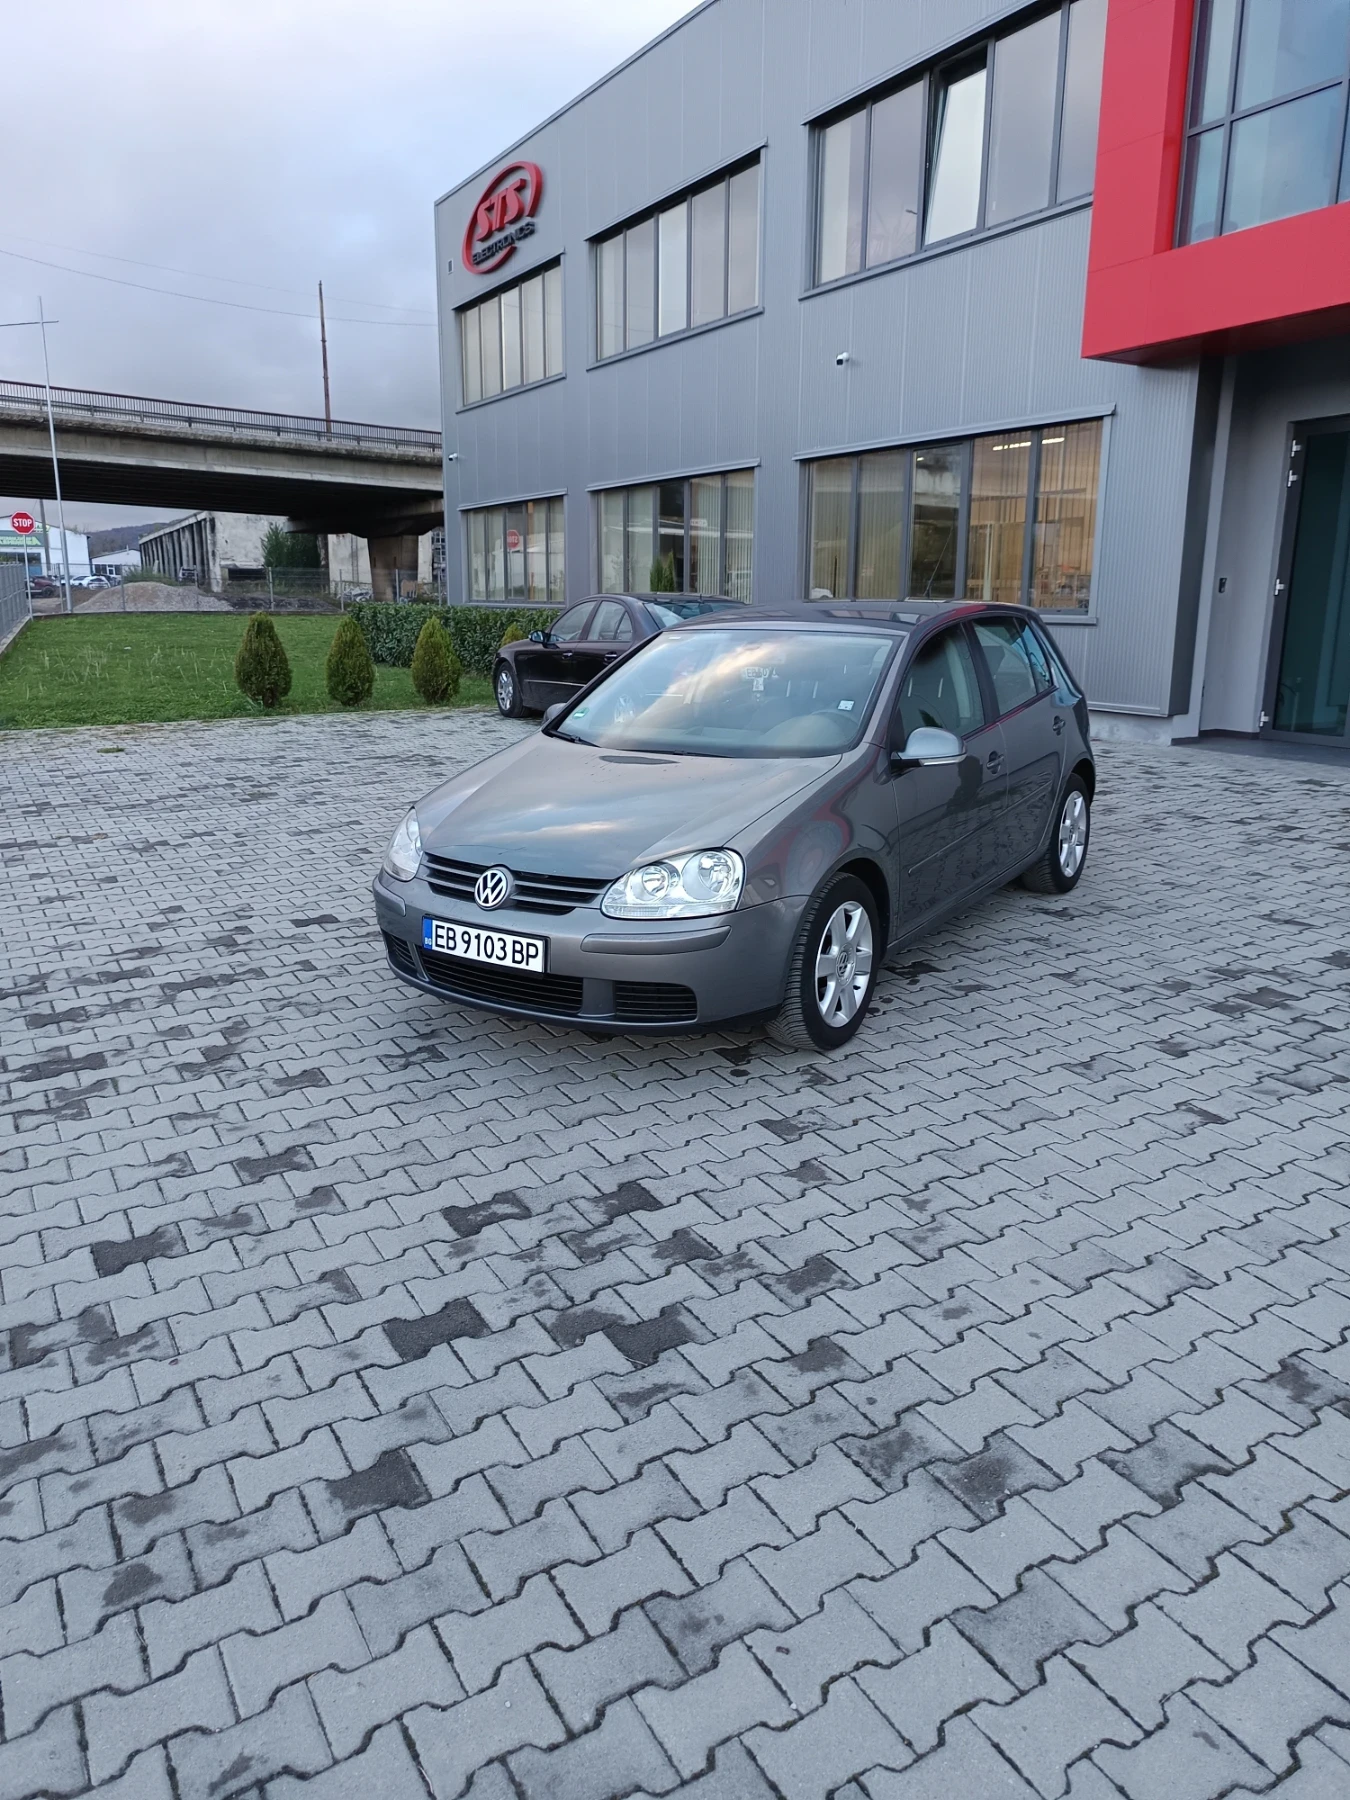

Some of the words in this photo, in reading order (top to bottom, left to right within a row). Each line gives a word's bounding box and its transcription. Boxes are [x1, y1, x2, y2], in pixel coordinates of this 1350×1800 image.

[476, 178, 526, 242] STS
[472, 221, 535, 265] ELECTRONICS
[13, 518, 32, 527] STOP
